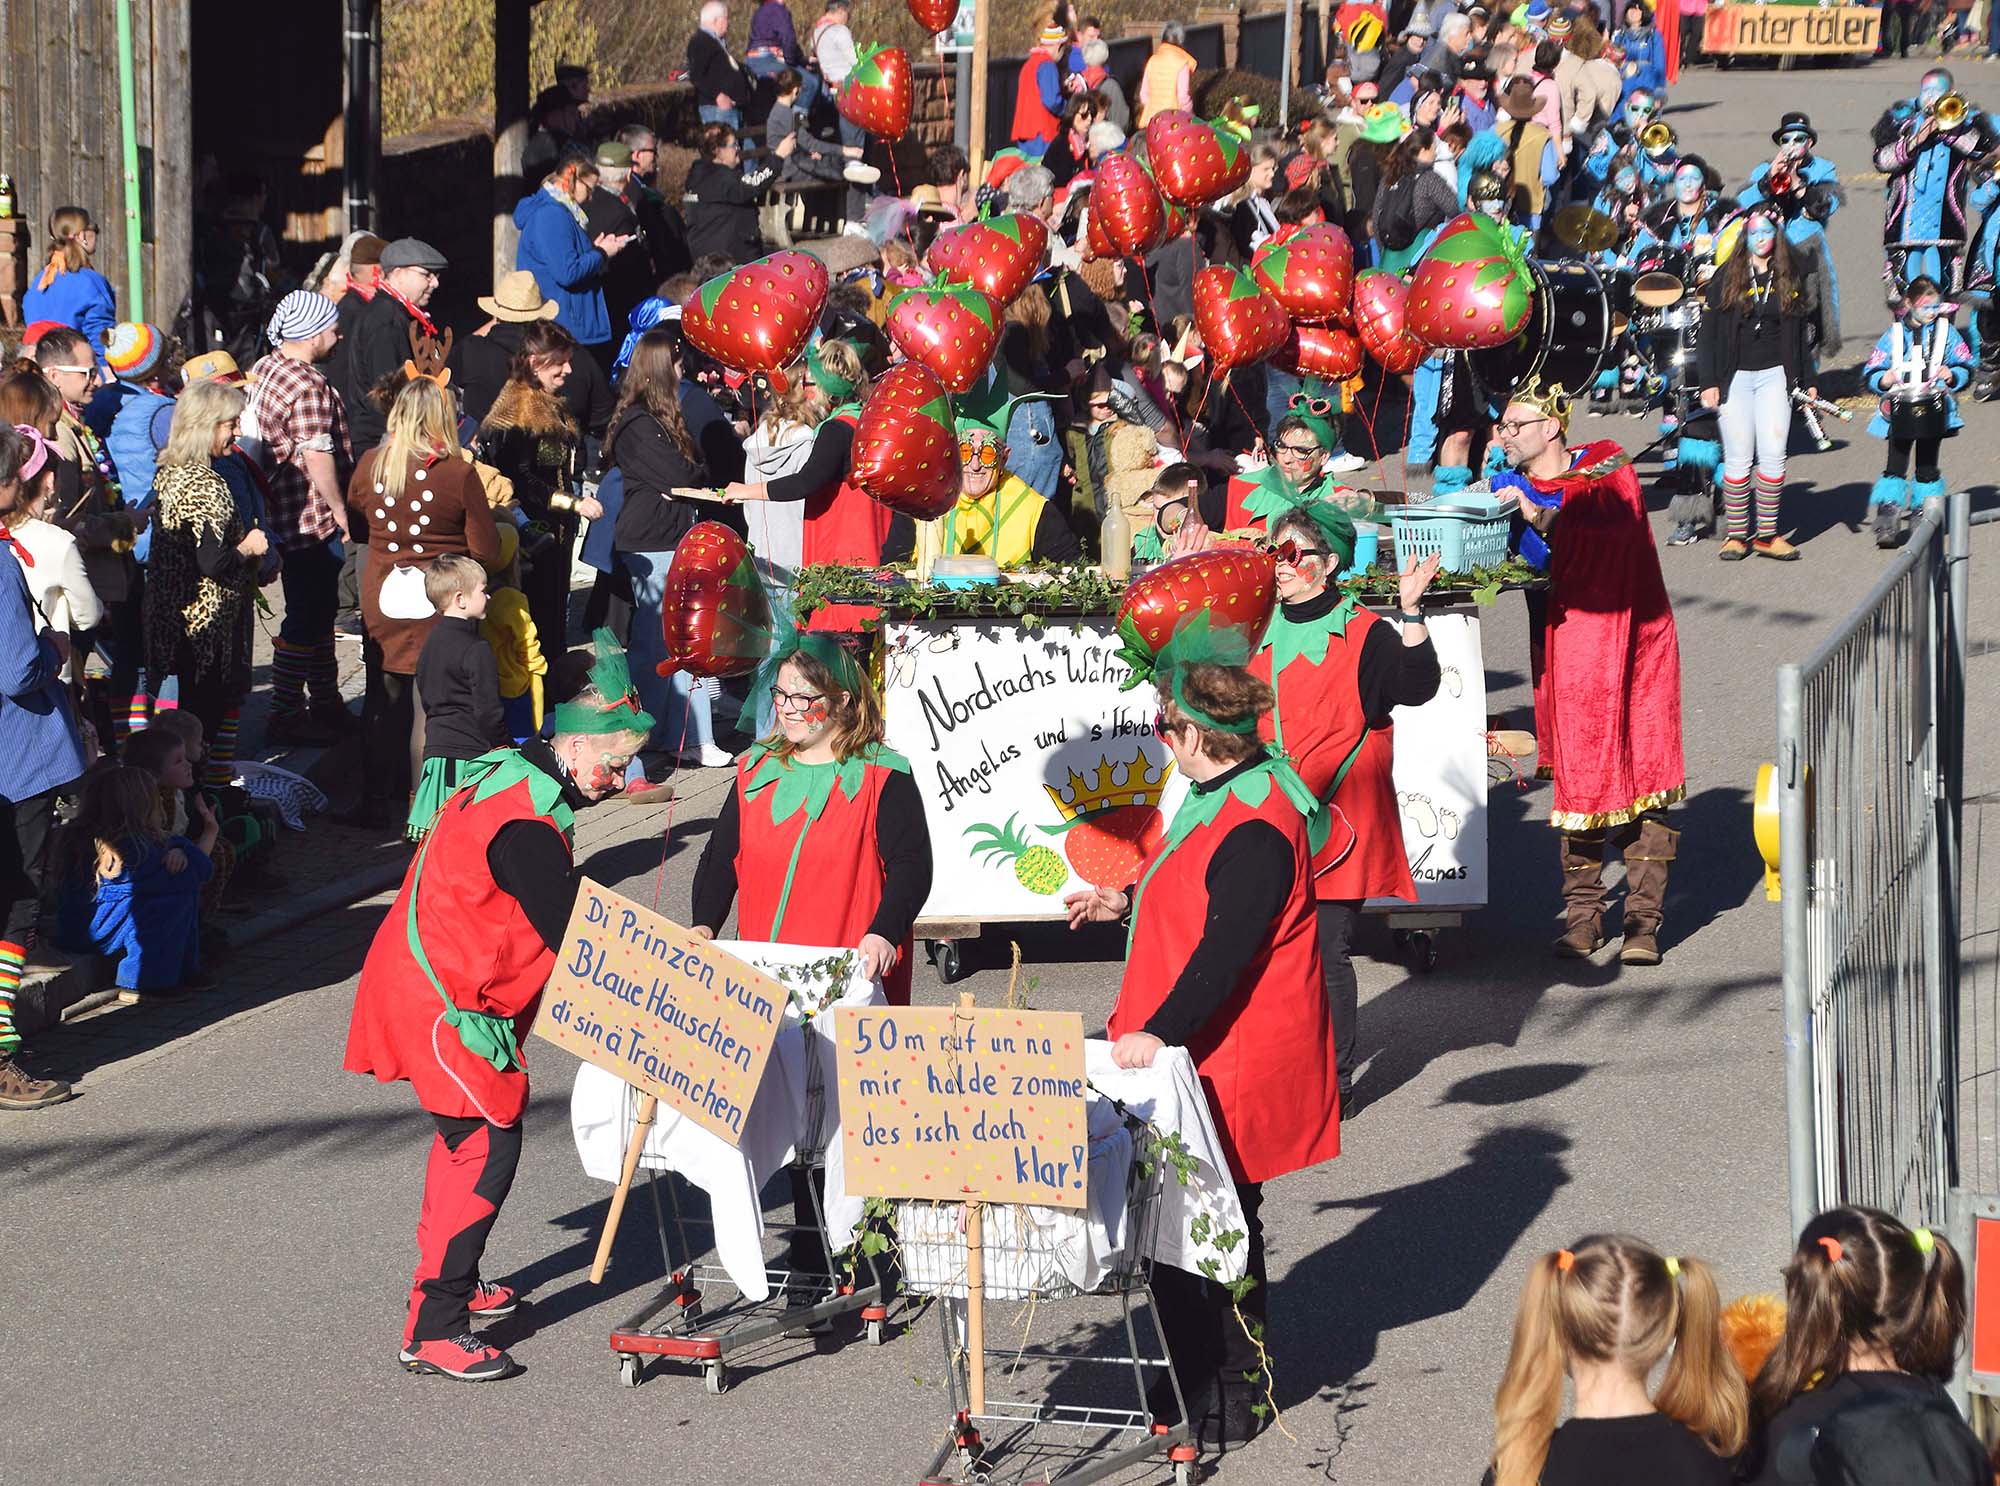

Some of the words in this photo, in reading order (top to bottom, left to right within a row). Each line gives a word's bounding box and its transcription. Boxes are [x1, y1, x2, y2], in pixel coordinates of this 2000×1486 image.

[917, 654, 1056, 752] Nordrachs
[1034, 718, 1068, 749] und
[585, 896, 611, 929] Di
[619, 909, 715, 990] Prinzen
[725, 977, 773, 1024] vum
[568, 939, 644, 1006] Blaue
[646, 978, 752, 1073] Häuschen
[940, 1023, 976, 1053] ruf
[991, 1036, 1016, 1054] un
[1026, 1036, 1052, 1055] na
[551, 1000, 573, 1025] di
[573, 1011, 604, 1043] sin
[606, 1025, 623, 1056] ä
[626, 1027, 743, 1135] Träumchen
[860, 1070, 902, 1096] mir
[927, 1061, 998, 1096] halde
[1011, 1076, 1083, 1097] zomme
[862, 1111, 900, 1146] des
[914, 1110, 960, 1142] isch
[972, 1108, 1026, 1142] doch
[1014, 1145, 1084, 1189] klar!
